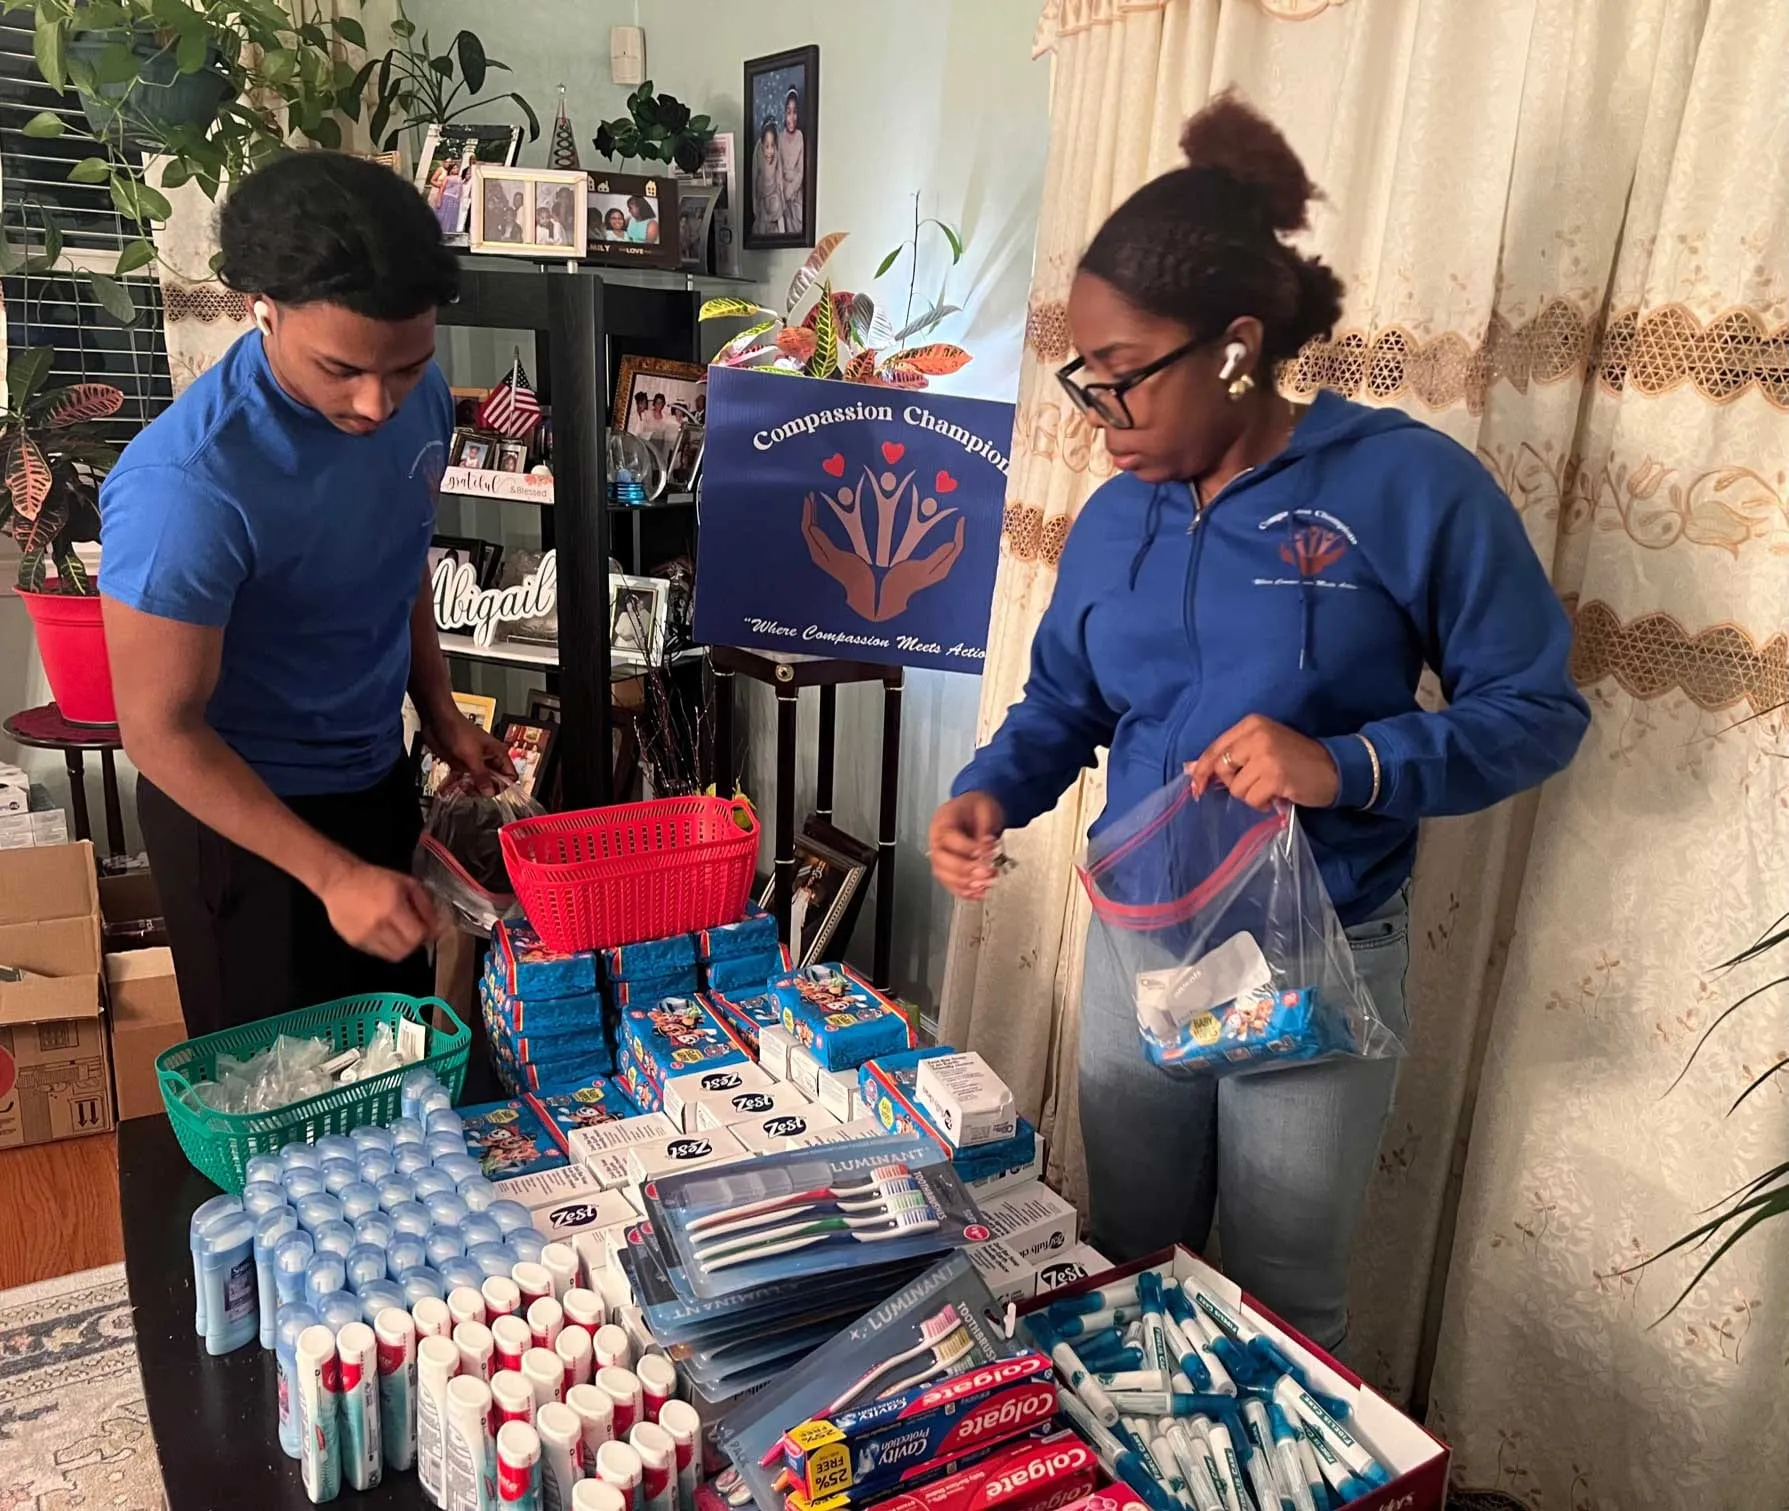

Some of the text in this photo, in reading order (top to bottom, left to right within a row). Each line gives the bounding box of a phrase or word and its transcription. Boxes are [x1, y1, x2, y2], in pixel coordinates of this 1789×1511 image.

[625, 247, 645, 255] LOVE
[752, 401, 1010, 477] Compassion Champion
[802, 625, 891, 649] Compassion
[896, 635, 941, 655] Meets
[704, 1073, 743, 1091] Zest
[736, 1093, 775, 1113] Zest
[766, 1116, 806, 1137] Zest
[670, 1138, 713, 1160] Zest
[831, 1148, 924, 1173] LUMINANT
[552, 1205, 598, 1229] Zest
[1042, 1263, 1088, 1290] Zest
[867, 1265, 955, 1331] LUMINANT
[922, 1359, 1041, 1407] Colgate
[958, 1392, 1054, 1438] Colgate
[878, 1438, 928, 1465] Cavity
[816, 1456, 845, 1474] FREE
[985, 1447, 1088, 1500] Colgate
[815, 1467, 849, 1490] 25%
